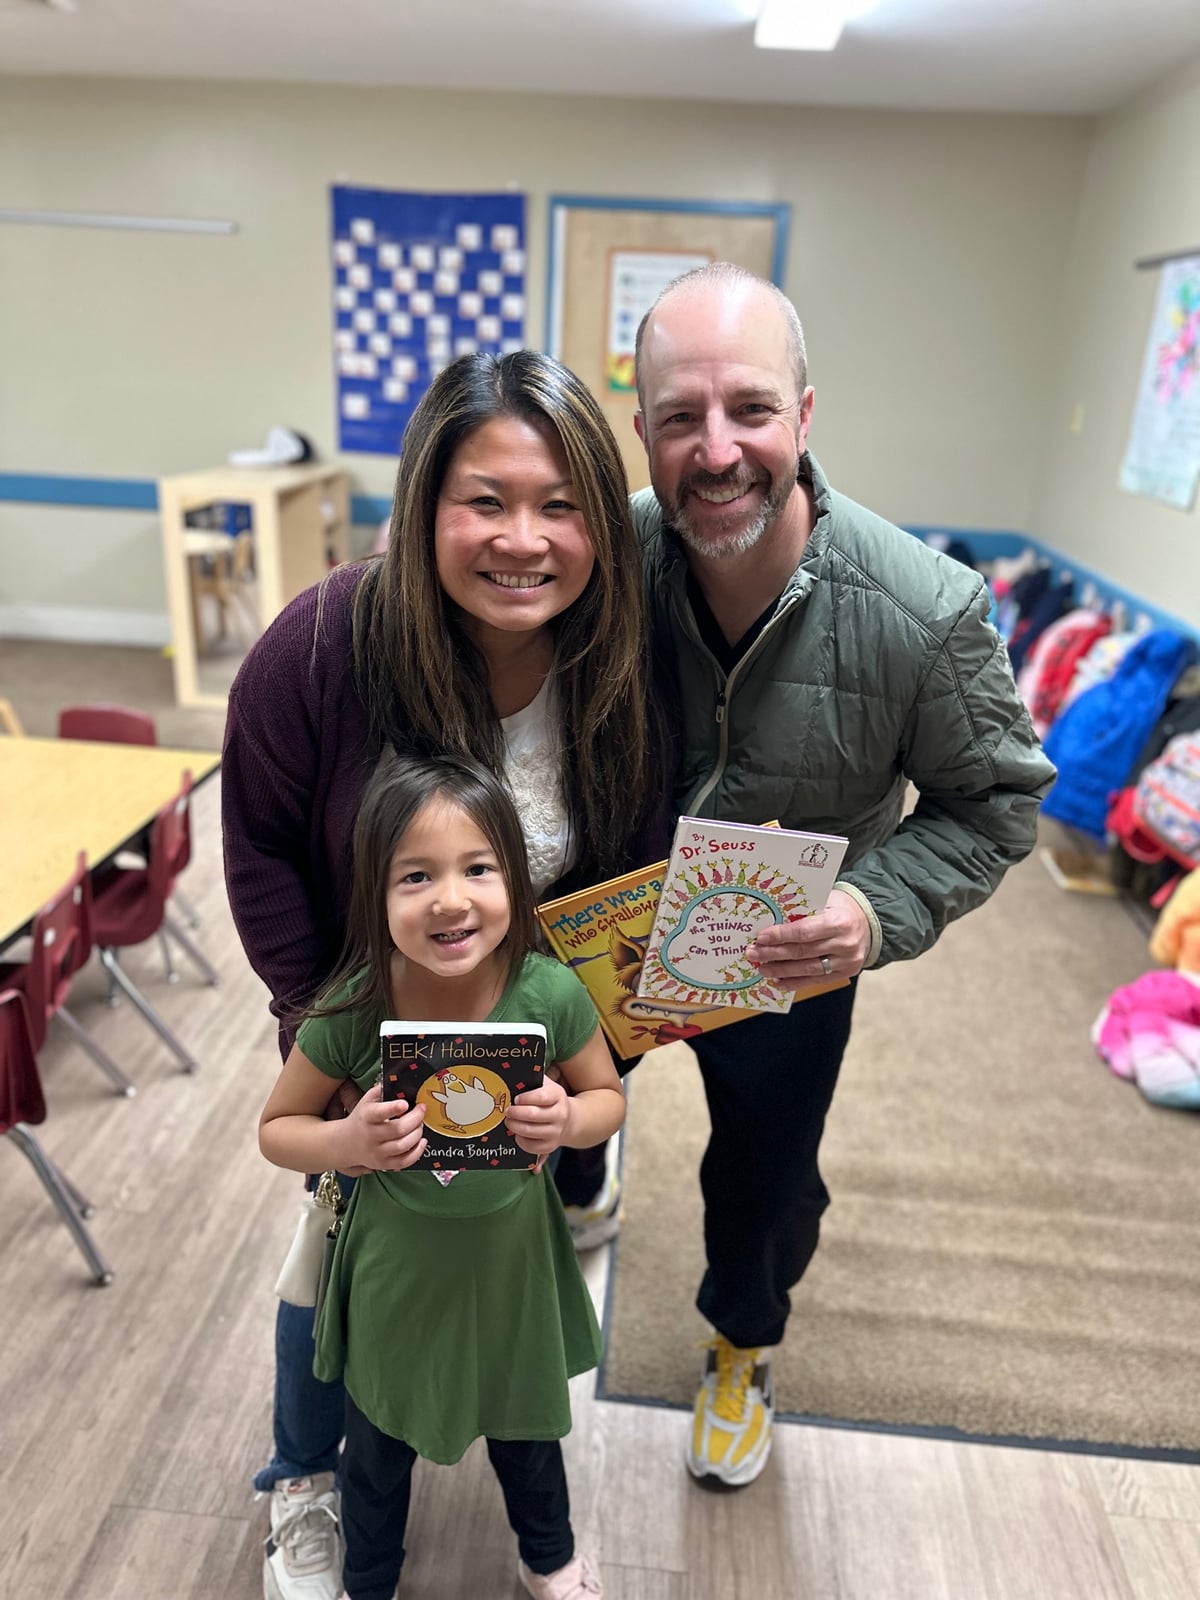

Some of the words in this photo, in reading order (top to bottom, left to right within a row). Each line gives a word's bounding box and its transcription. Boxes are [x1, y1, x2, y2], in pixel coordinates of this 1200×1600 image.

[692, 833, 705, 842] By
[679, 846, 706, 859] Dr.
[708, 839, 755, 853] Seuss
[550, 902, 608, 935] There
[649, 879, 662, 892] a
[689, 925, 706, 935] the
[708, 935, 731, 945] you
[389, 1042, 435, 1060] EEK!
[441, 1041, 539, 1058] Halloween!
[423, 1144, 465, 1158] Sandra
[465, 1143, 516, 1161] Boynton
